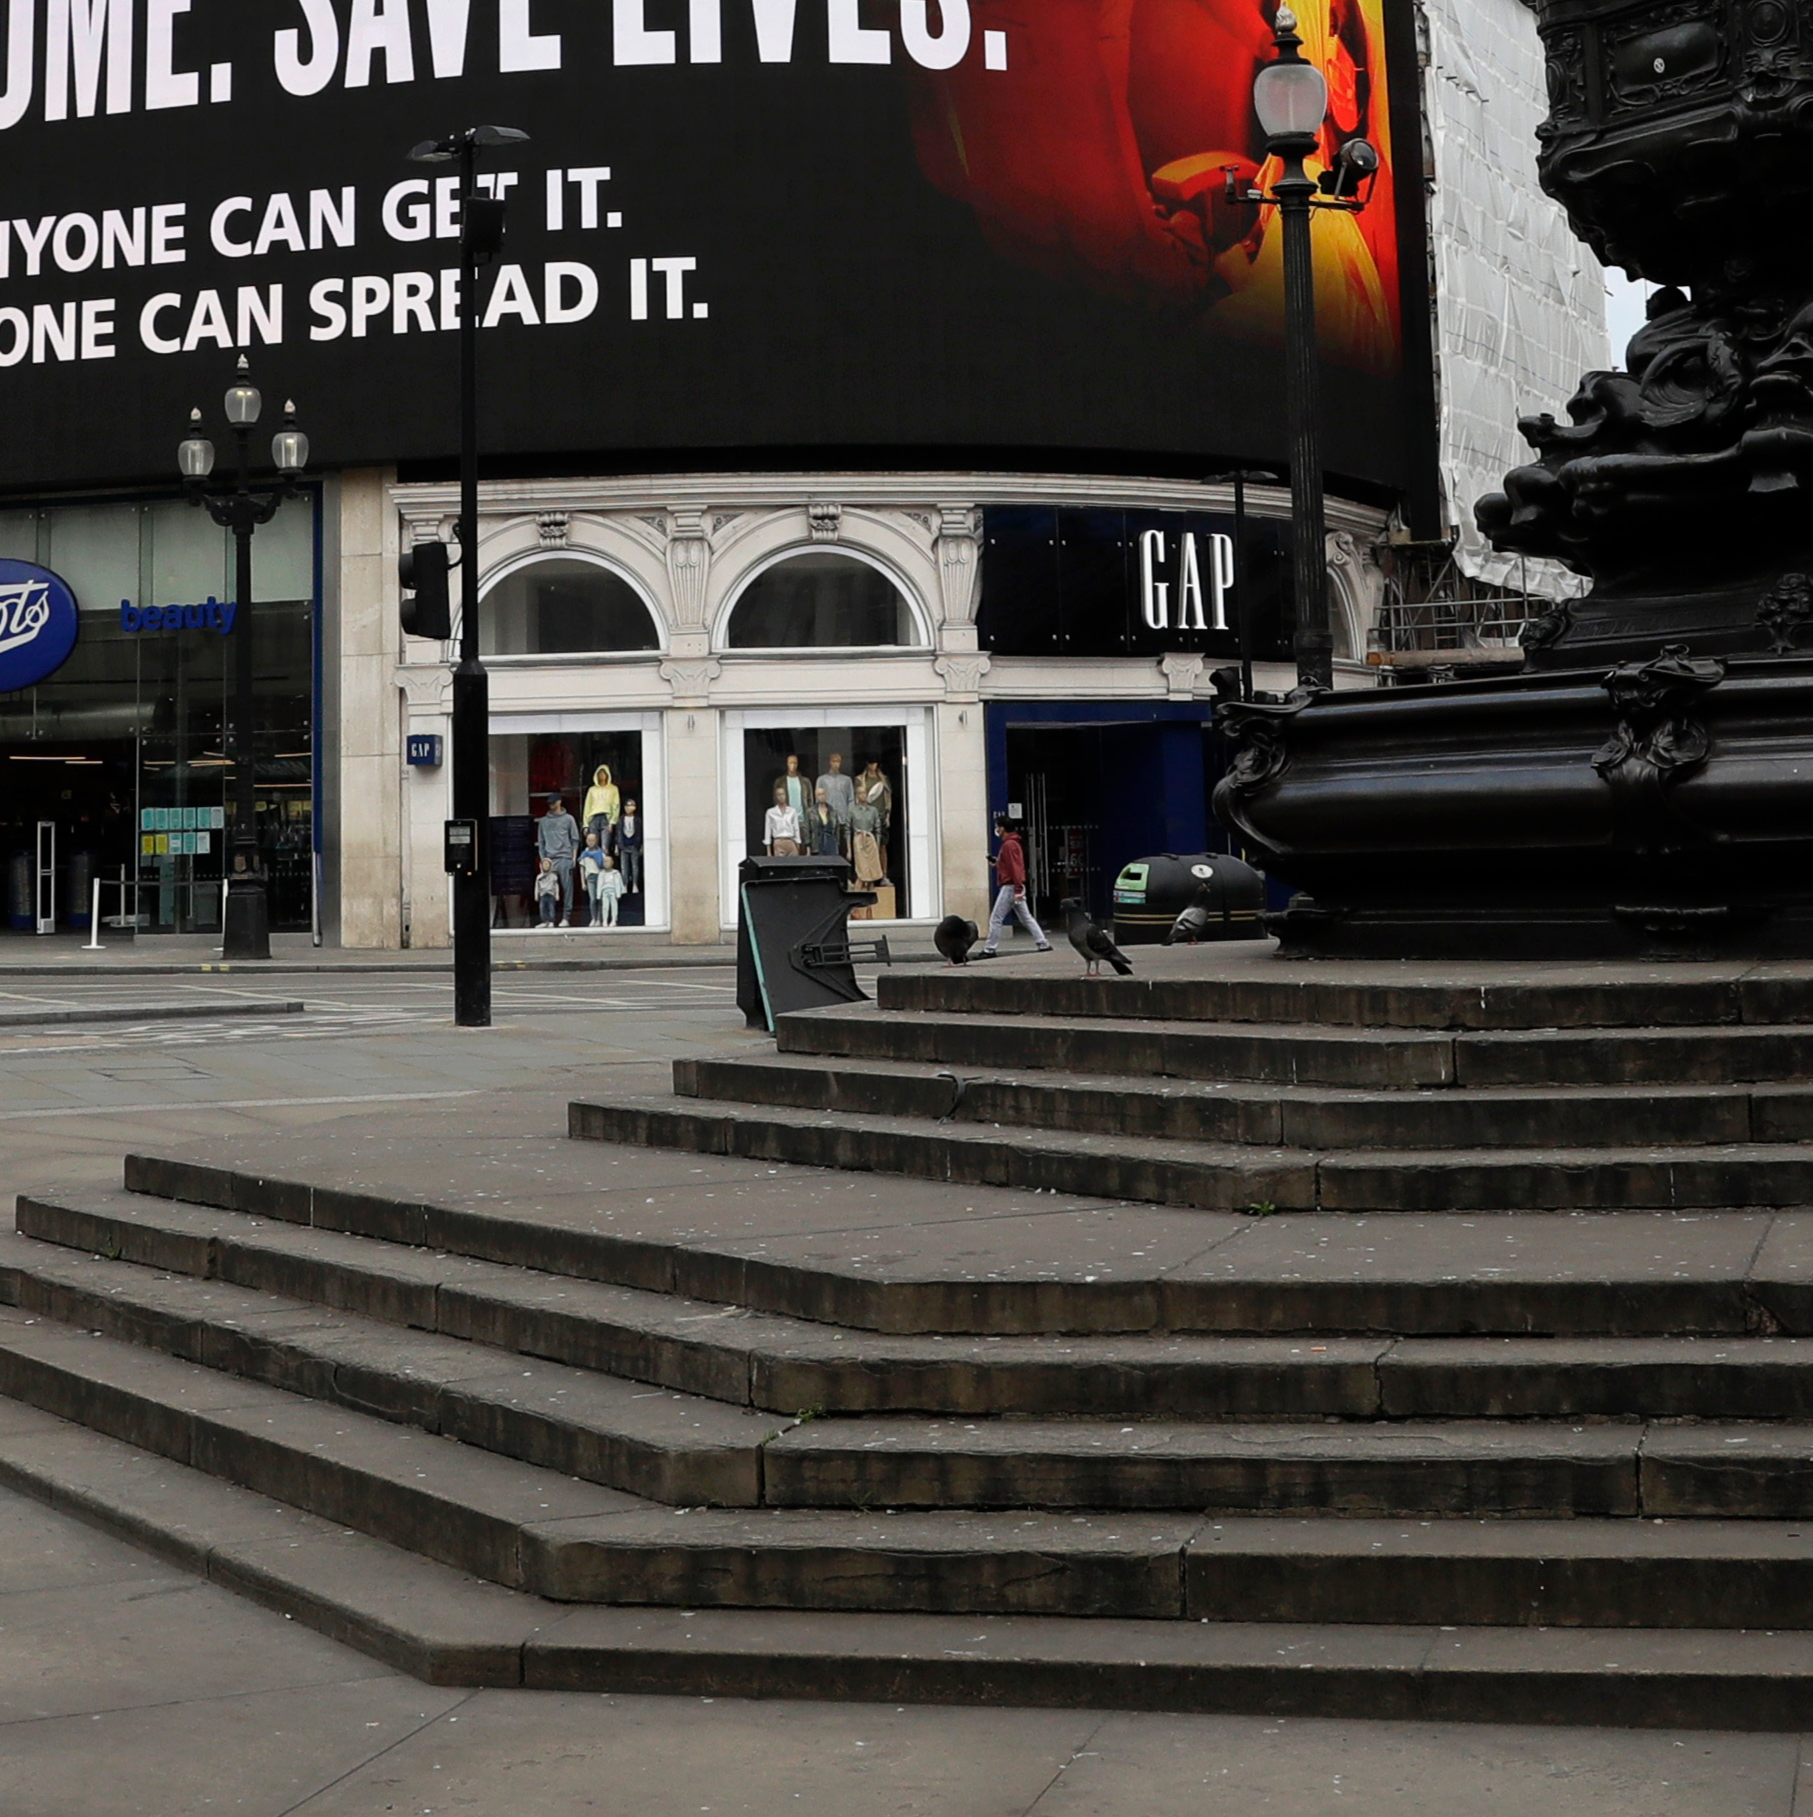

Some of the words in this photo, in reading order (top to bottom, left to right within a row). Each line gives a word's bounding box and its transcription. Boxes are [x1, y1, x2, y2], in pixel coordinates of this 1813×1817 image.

[209, 186, 356, 258] CAN
[547, 166, 623, 231] IT.
[139, 283, 283, 353] CAN
[308, 261, 600, 342] SPREAD
[629, 256, 710, 321] IT.
[120, 596, 237, 635] beauty
[1139, 529, 1234, 630] GAP
[411, 743, 430, 757] GAP
